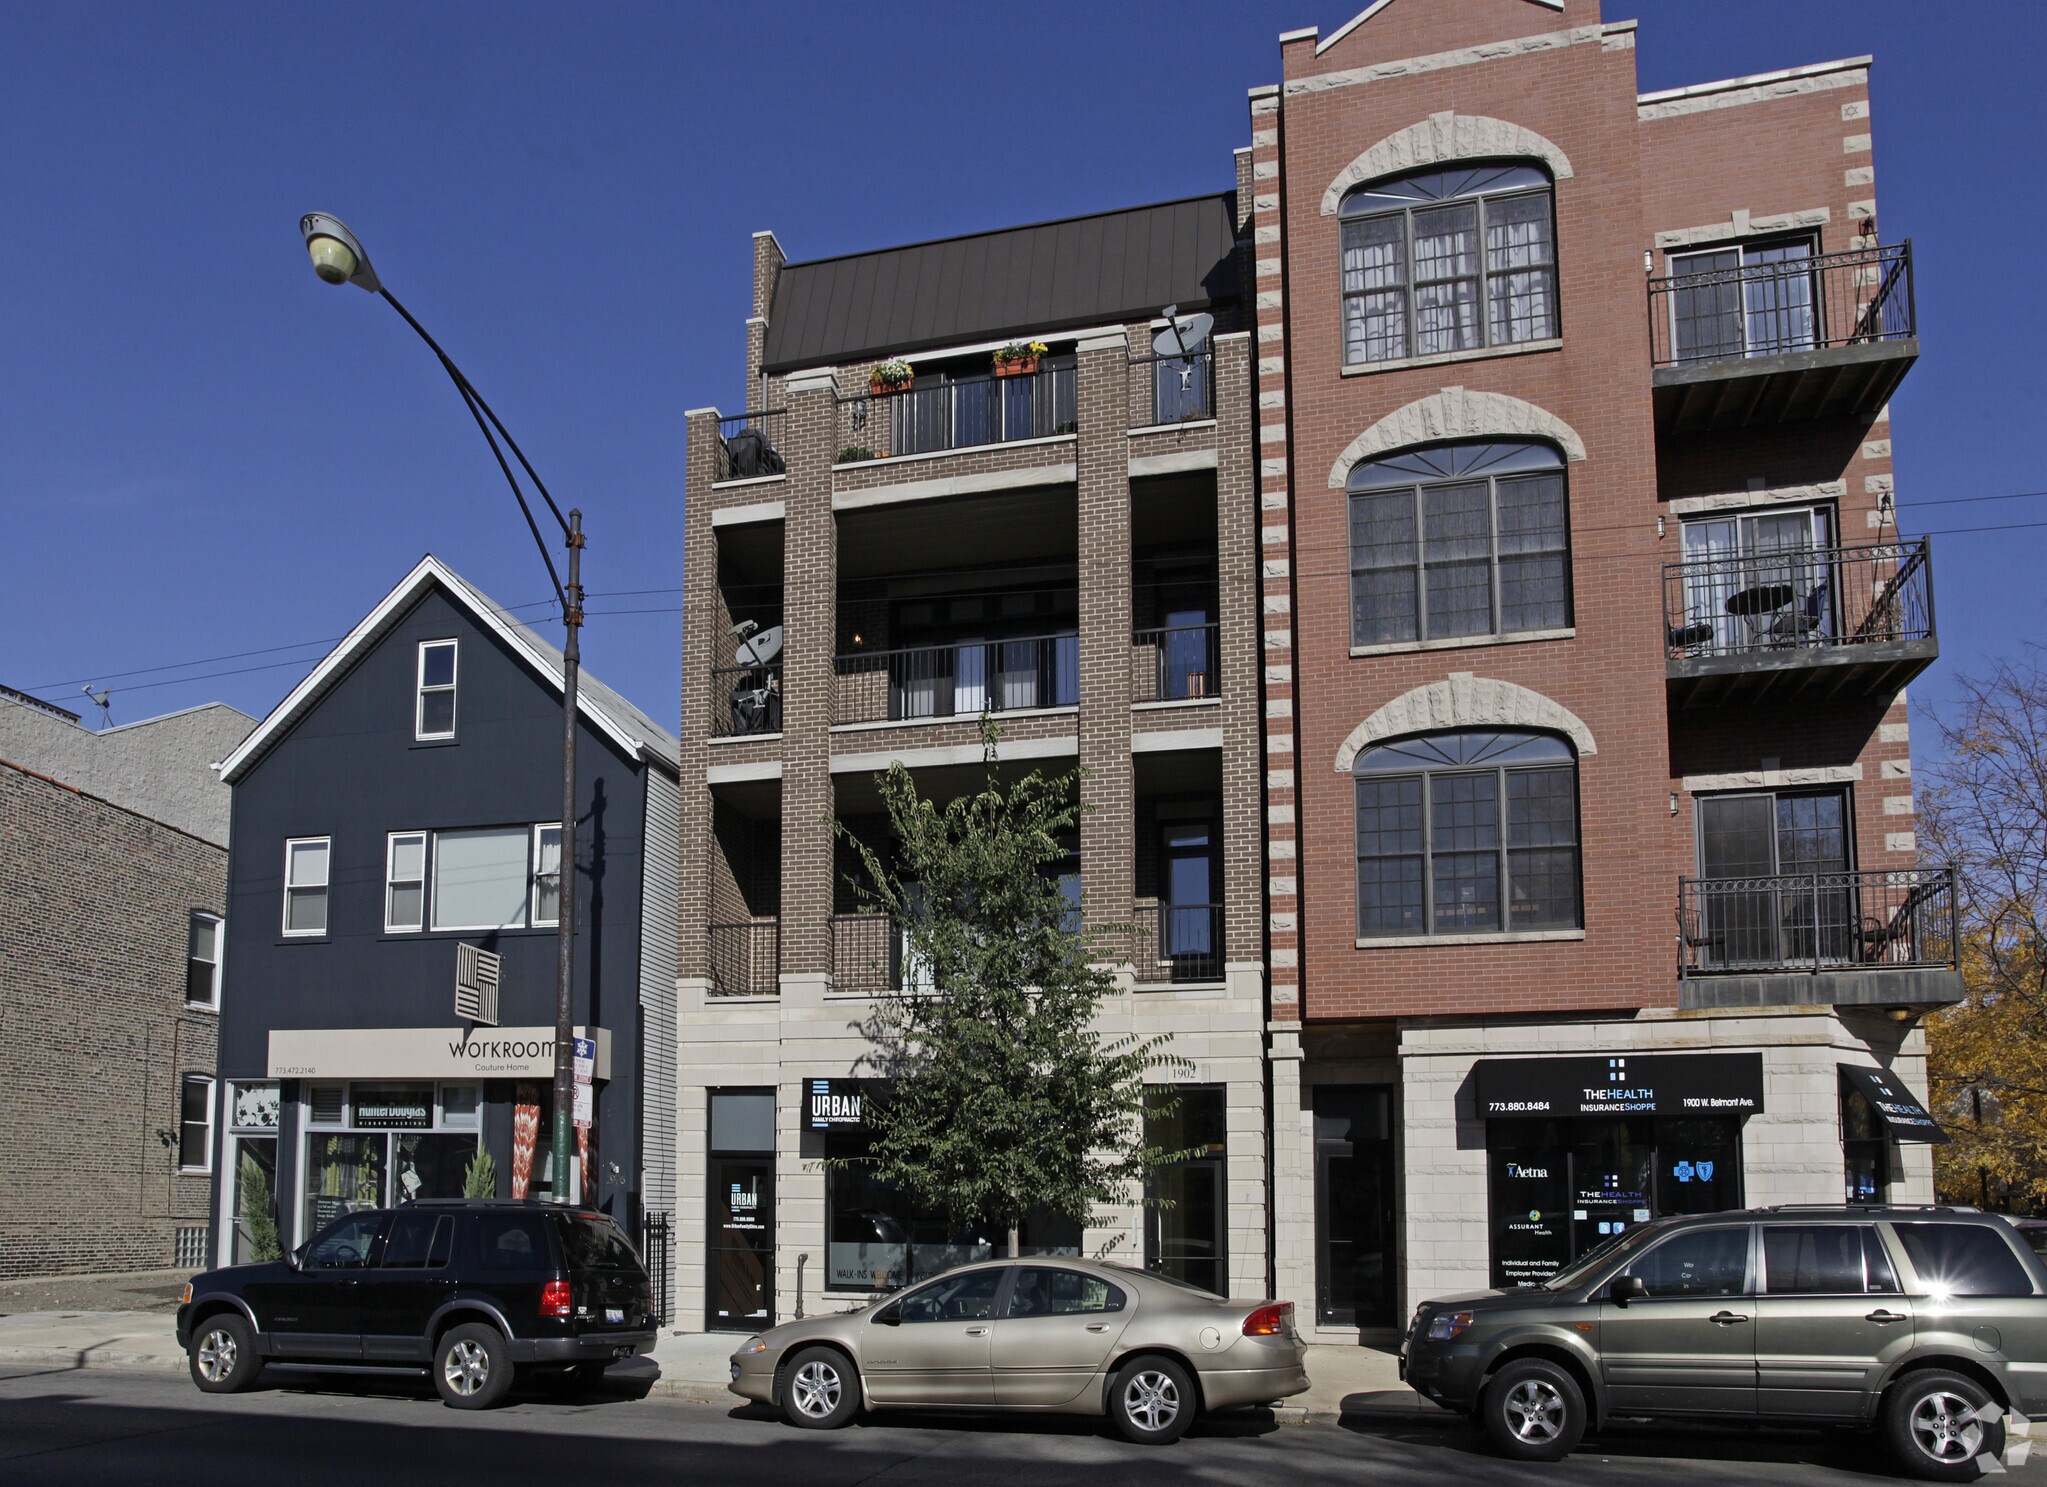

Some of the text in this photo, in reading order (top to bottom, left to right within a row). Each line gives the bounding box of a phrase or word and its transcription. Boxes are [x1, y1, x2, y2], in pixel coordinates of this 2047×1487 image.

[475, 1063, 530, 1071] Couture Home
[1173, 1069, 1196, 1079] 1902
[812, 1095, 861, 1117] URBAN
[1489, 1101, 1550, 1112] 773.880.8484
[1683, 1097, 1755, 1107] 1900 W. Belmont Ave.
[1515, 1165, 1549, 1178] Aetna
[731, 1193, 757, 1206] URBAN
[1542, 1260, 1560, 1268] Family
[836, 1269, 868, 1280] WALK-INS
[870, 1269, 903, 1281] WELCOME
